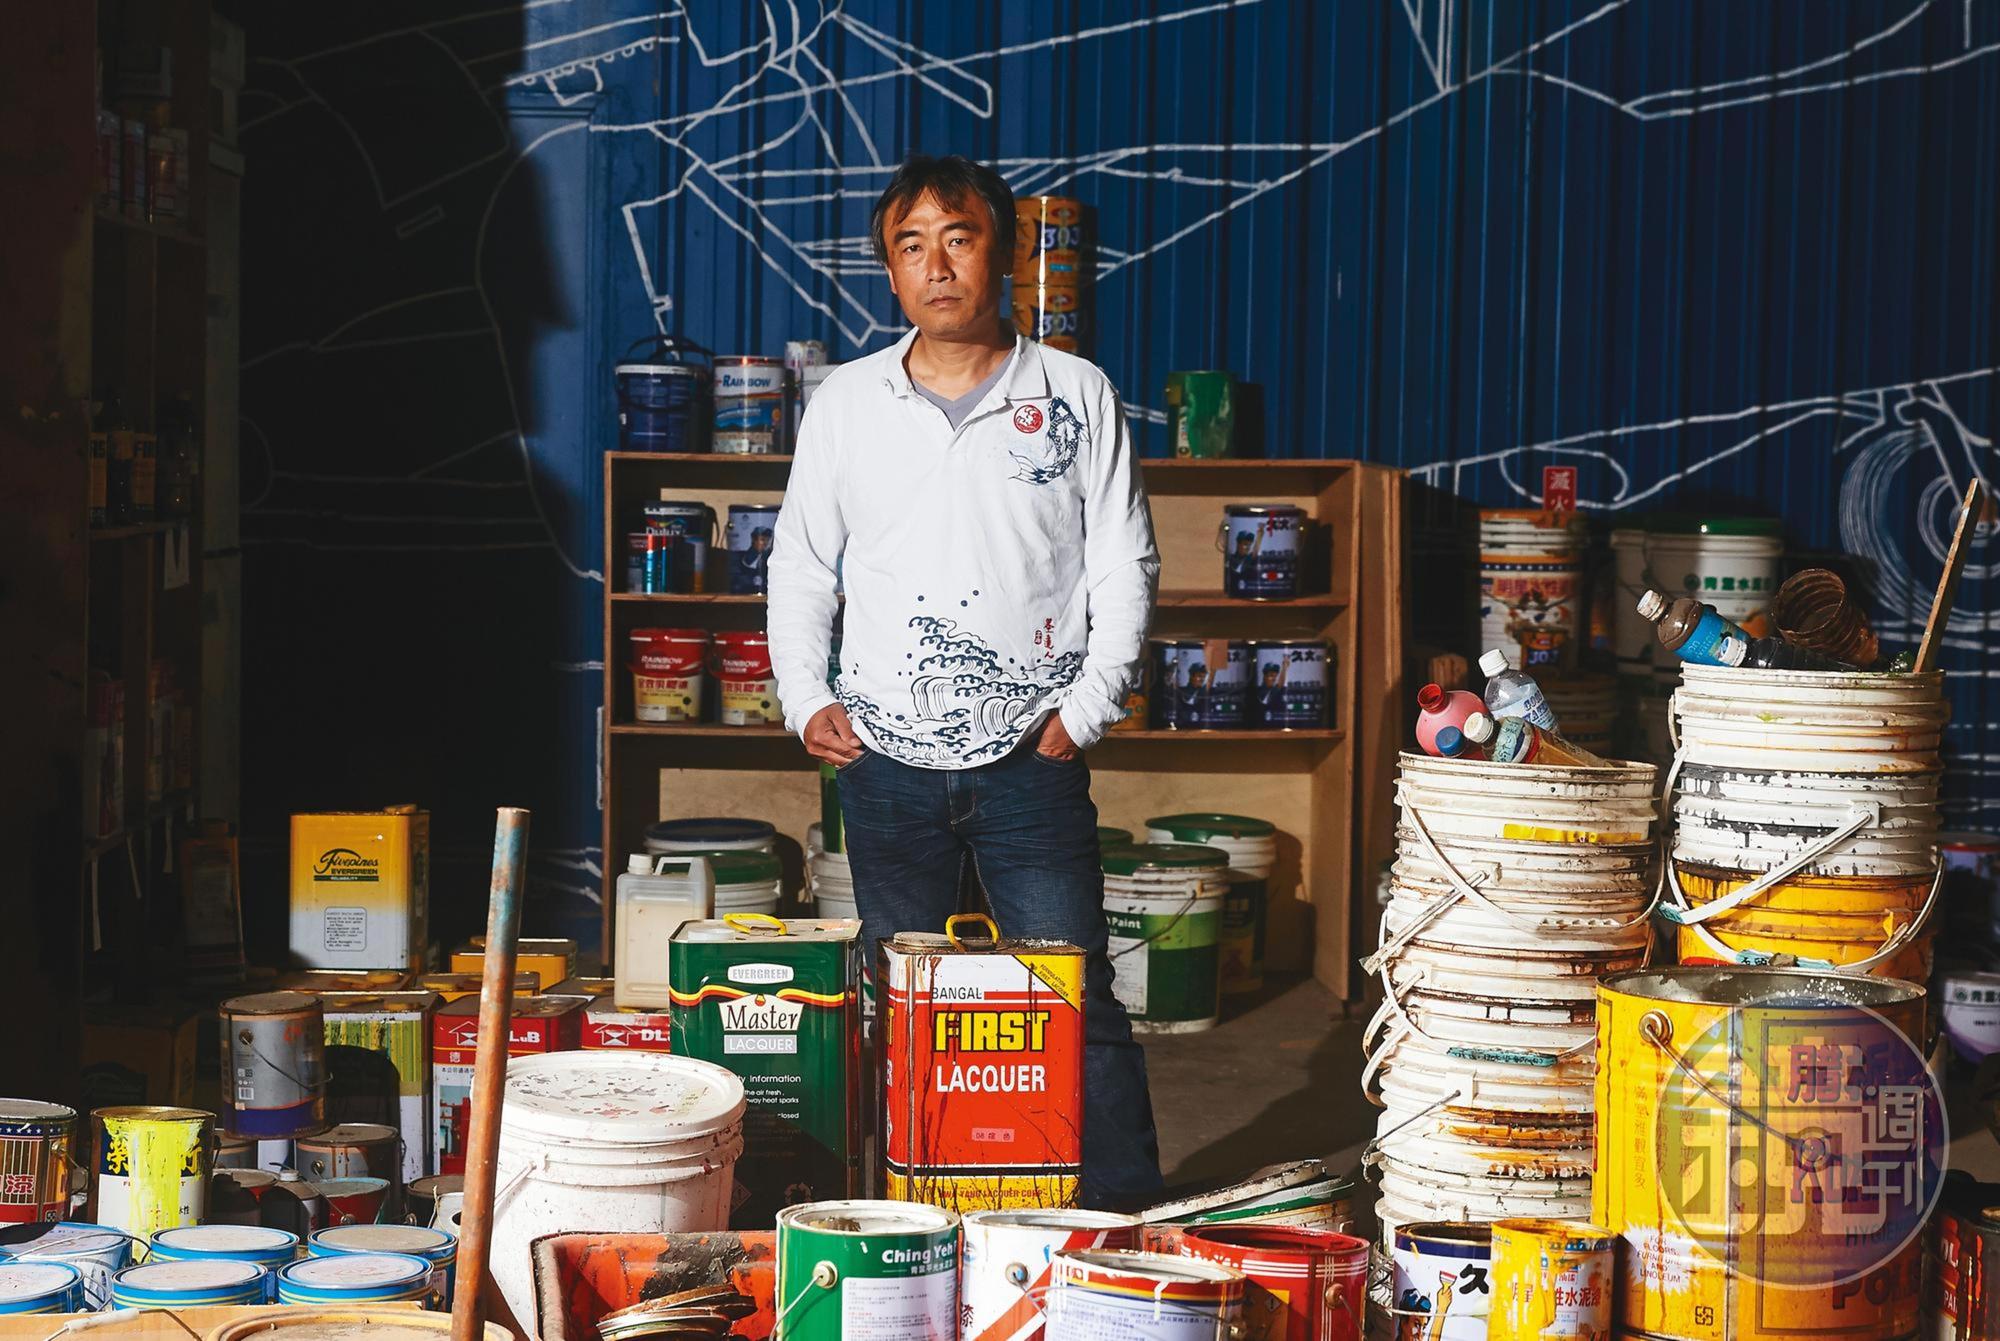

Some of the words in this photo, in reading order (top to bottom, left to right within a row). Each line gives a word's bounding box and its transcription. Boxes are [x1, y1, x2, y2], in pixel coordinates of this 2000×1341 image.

[1111, 916, 1142, 930] Paint
[732, 968, 789, 980] EVERGREEN
[931, 986, 983, 1000] BANGAL
[724, 1003, 799, 1031] Master
[509, 1030, 541, 1044] LuB
[641, 1029, 670, 1042] DL
[934, 1010, 1051, 1053] FIRST
[728, 1038, 794, 1052] LACQUER
[749, 1074, 802, 1083] Information
[936, 1064, 1046, 1093] LACQUER
[881, 1248, 932, 1264] Ching
[933, 1242, 954, 1259] Yeh
[1458, 1263, 1490, 1295] 久
